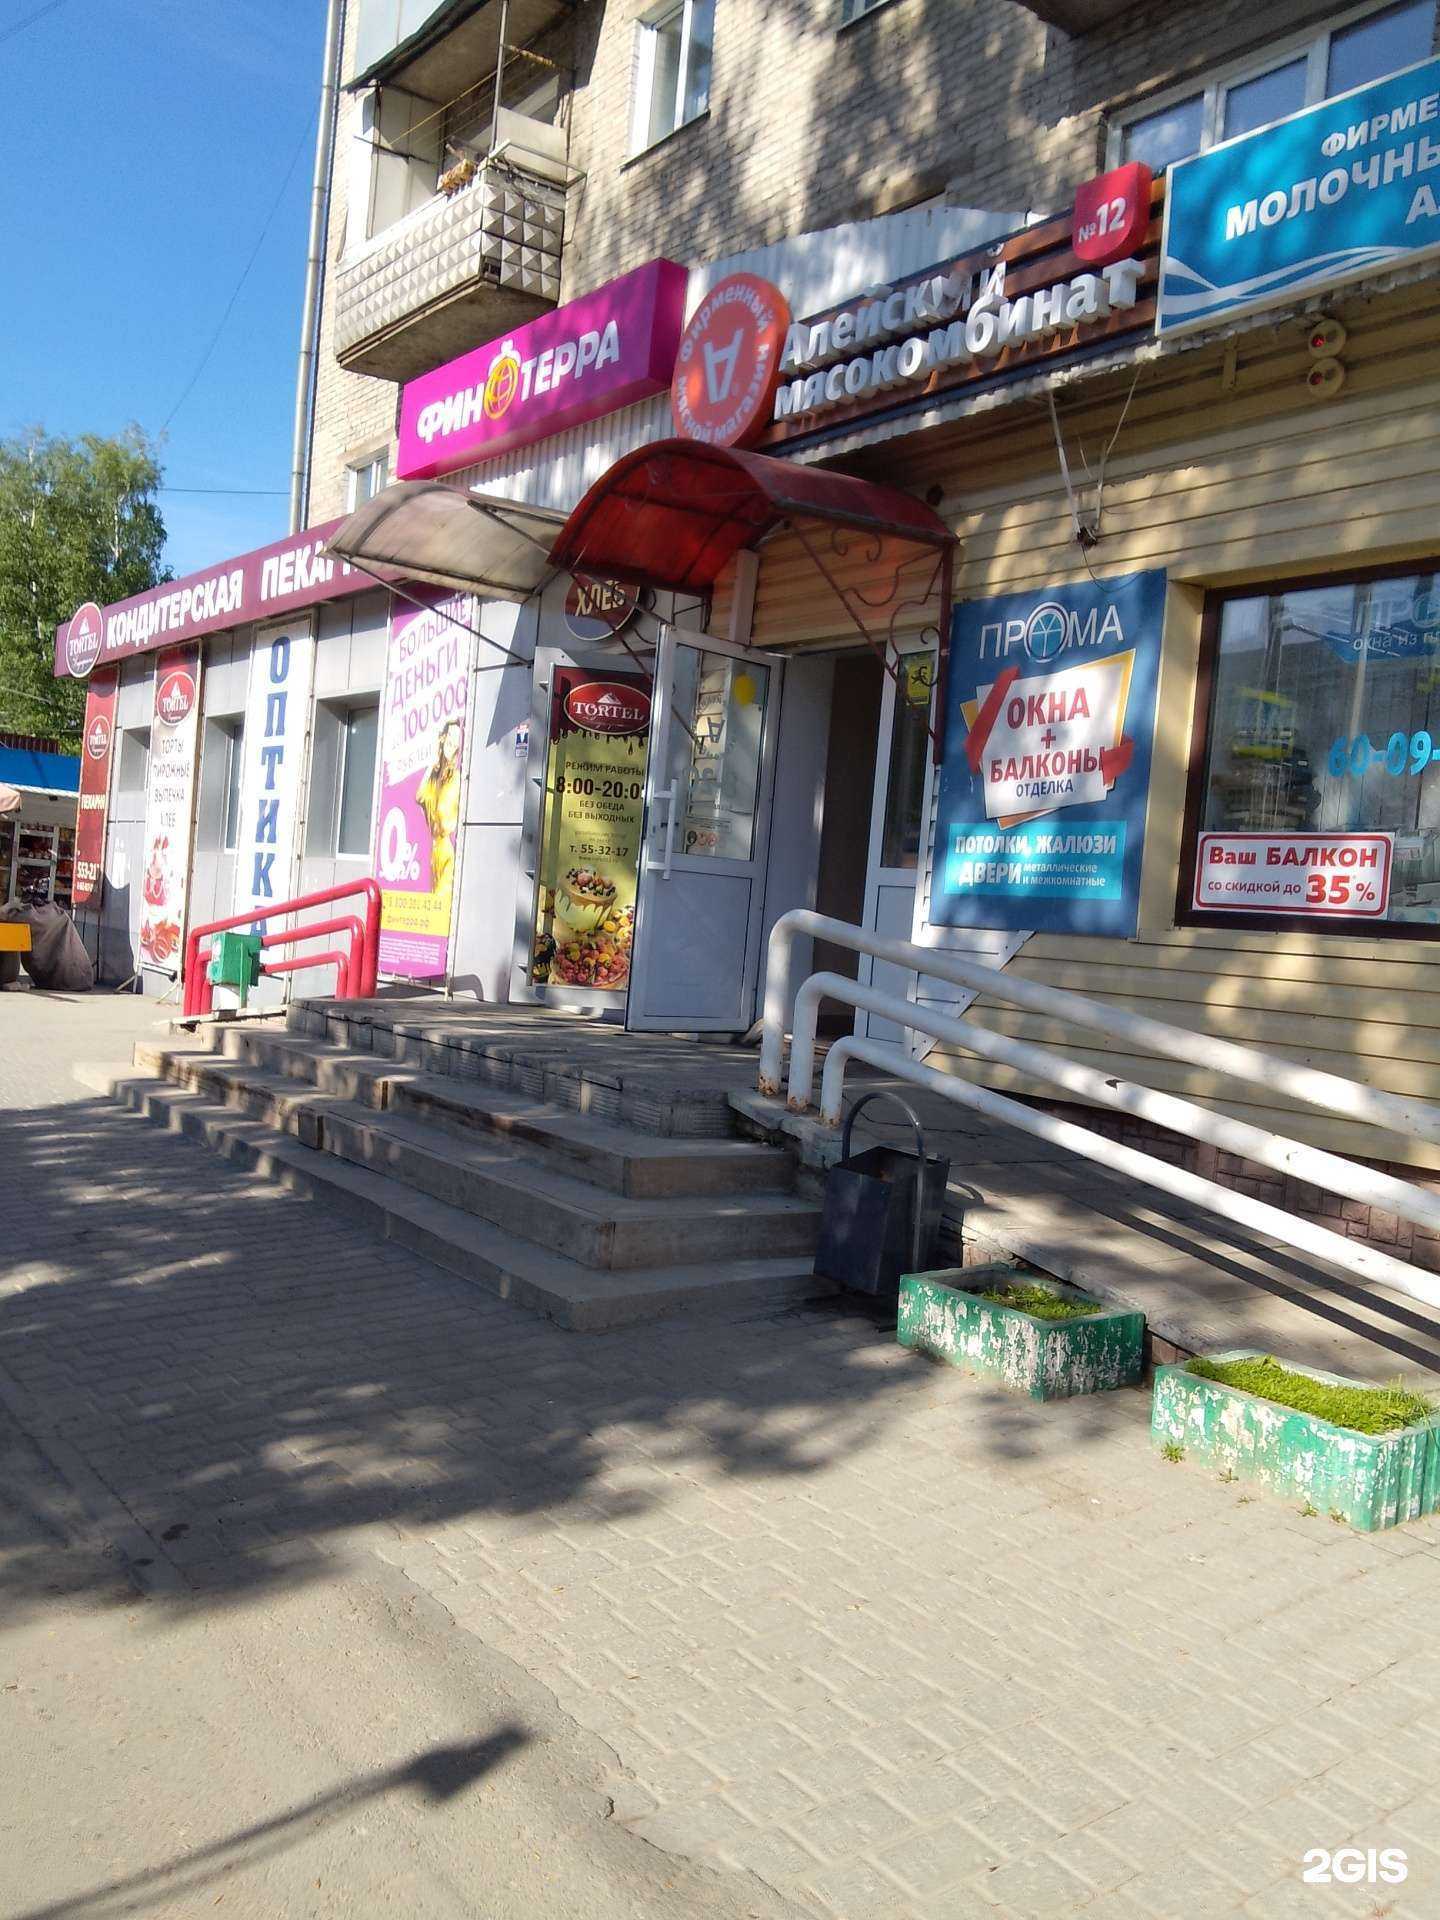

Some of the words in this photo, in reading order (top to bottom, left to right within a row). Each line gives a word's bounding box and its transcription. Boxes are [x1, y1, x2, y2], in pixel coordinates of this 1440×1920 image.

[774, 258, 1146, 422] мясокомбинат
[106, 568, 244, 649] КОНДИТЕРСКАЯ
[391, 637, 459, 714] ДЕНЬГИ
[572, 701, 645, 721] TORTEL
[1007, 687, 1090, 730] ОКНА
[990, 746, 1105, 783] БАЛКОНЫ
[250, 636, 291, 937] ОПТИКА
[556, 776, 645, 800] 8:00-20:0
[1016, 779, 1074, 798] ОТДЕЛКА
[584, 812, 635, 824] ВЫХОДНЫХ
[581, 844, 629, 857] 55-32-17
[1036, 835, 1117, 854] ЖАЛЮЗИ
[1209, 846, 1257, 865] Ваш
[1266, 847, 1378, 868] БАЛКОН
[959, 862, 1023, 887] ДВЕРИ
[1023, 863, 1098, 873] металлические
[1030, 876, 1106, 887] межкомнатные
[1208, 880, 1222, 890] со
[1225, 880, 1281, 894] скидкой
[1283, 883, 1302, 896] до
